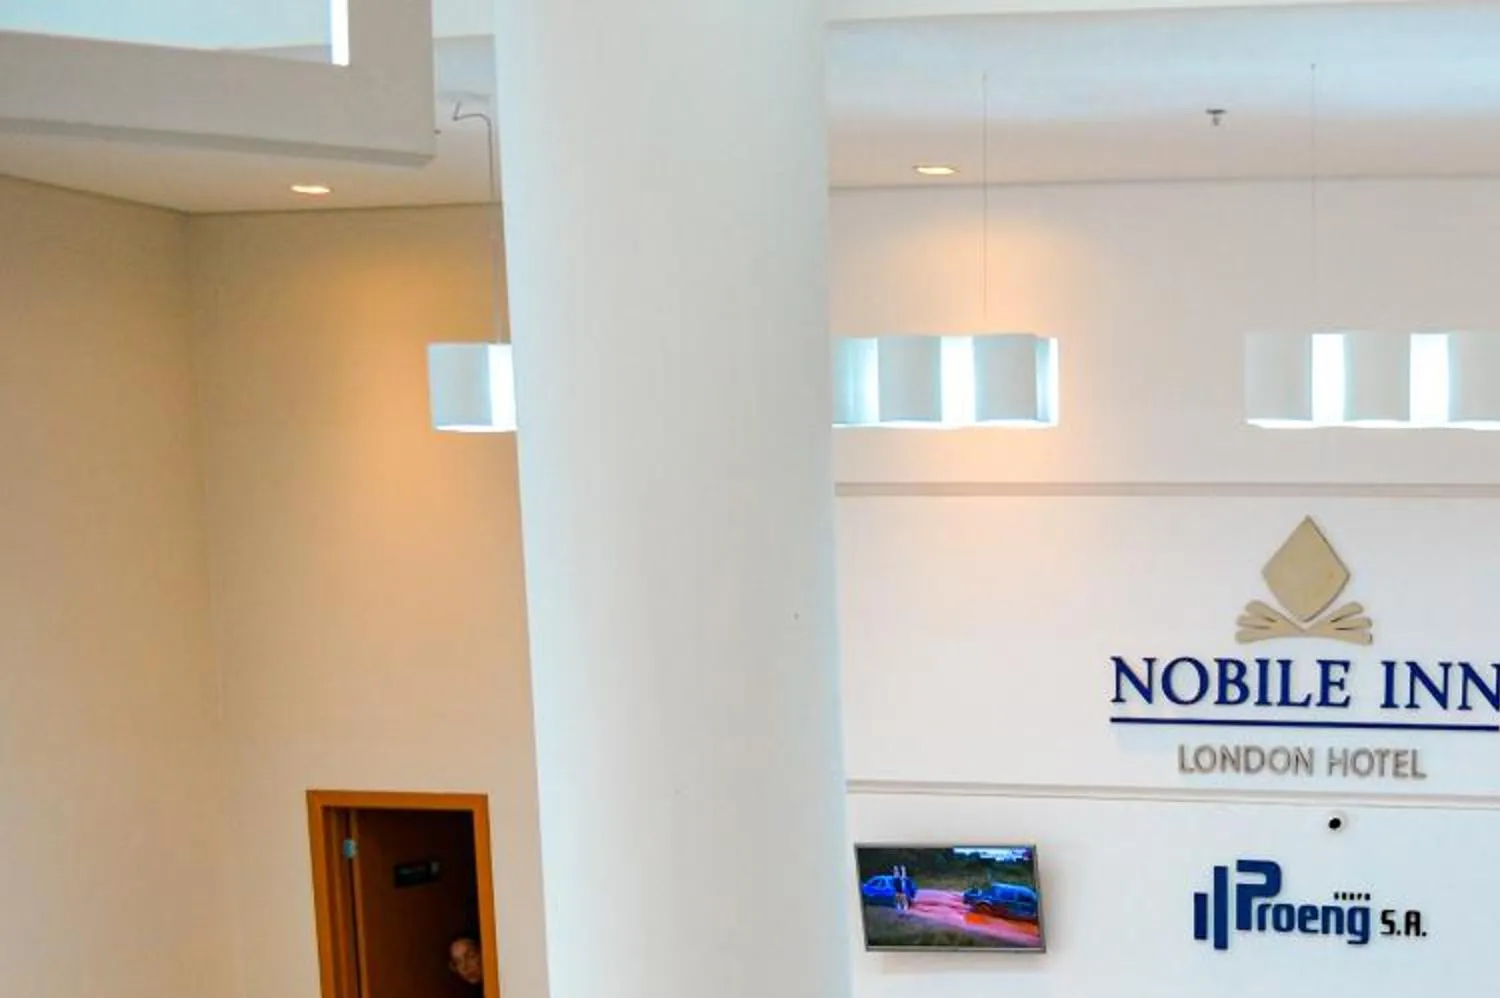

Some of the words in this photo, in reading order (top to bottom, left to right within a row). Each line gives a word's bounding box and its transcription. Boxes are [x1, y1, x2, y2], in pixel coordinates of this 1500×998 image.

[1110, 655, 1352, 708] NOBILE
[1178, 743, 1314, 776] LONDON
[1327, 748, 1428, 780] HOTEL
[1235, 859, 1371, 945] Proeng
[1379, 908, 1428, 938] S.A.
